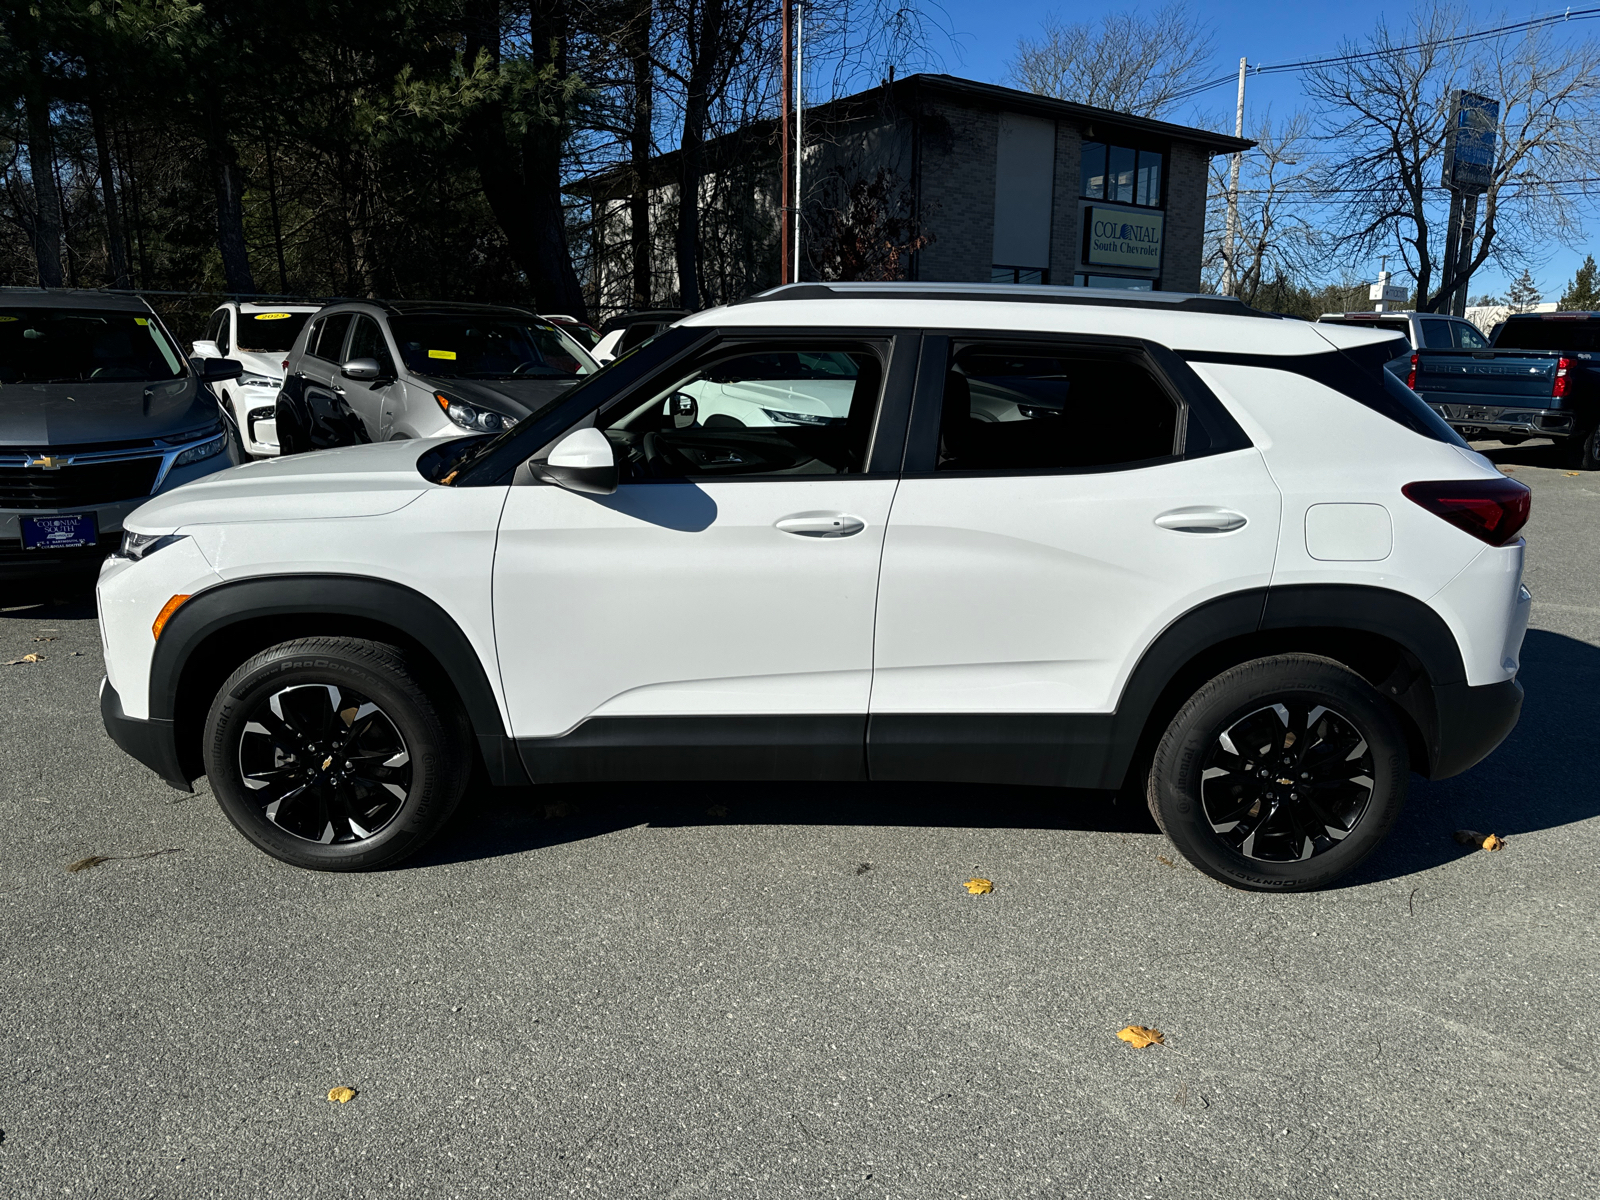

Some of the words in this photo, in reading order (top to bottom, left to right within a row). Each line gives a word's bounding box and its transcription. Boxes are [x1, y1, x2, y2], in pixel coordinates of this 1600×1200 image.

[1094, 220, 1159, 244] COLONIAL
[1093, 239, 1118, 252] South
[1120, 241, 1158, 256] Chevrolet
[36, 519, 81, 528] COLONIAL
[44, 525, 75, 533] SOUTH
